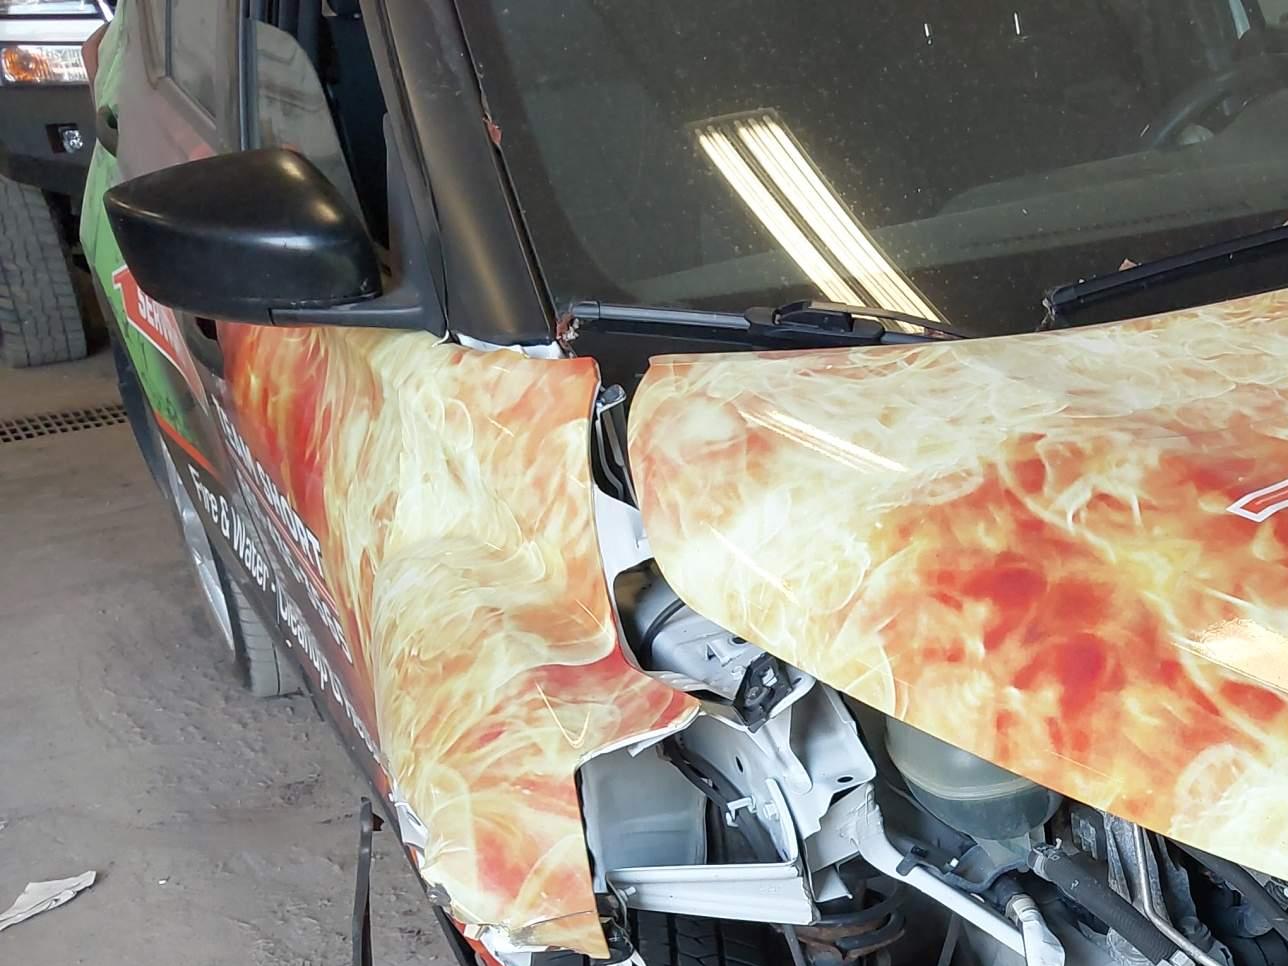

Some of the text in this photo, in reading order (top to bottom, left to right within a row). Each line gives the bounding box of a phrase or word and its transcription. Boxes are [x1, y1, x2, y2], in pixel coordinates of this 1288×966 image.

[188, 463, 218, 524] Fire
[231, 506, 270, 592] Water
[256, 460, 324, 579] SHORT
